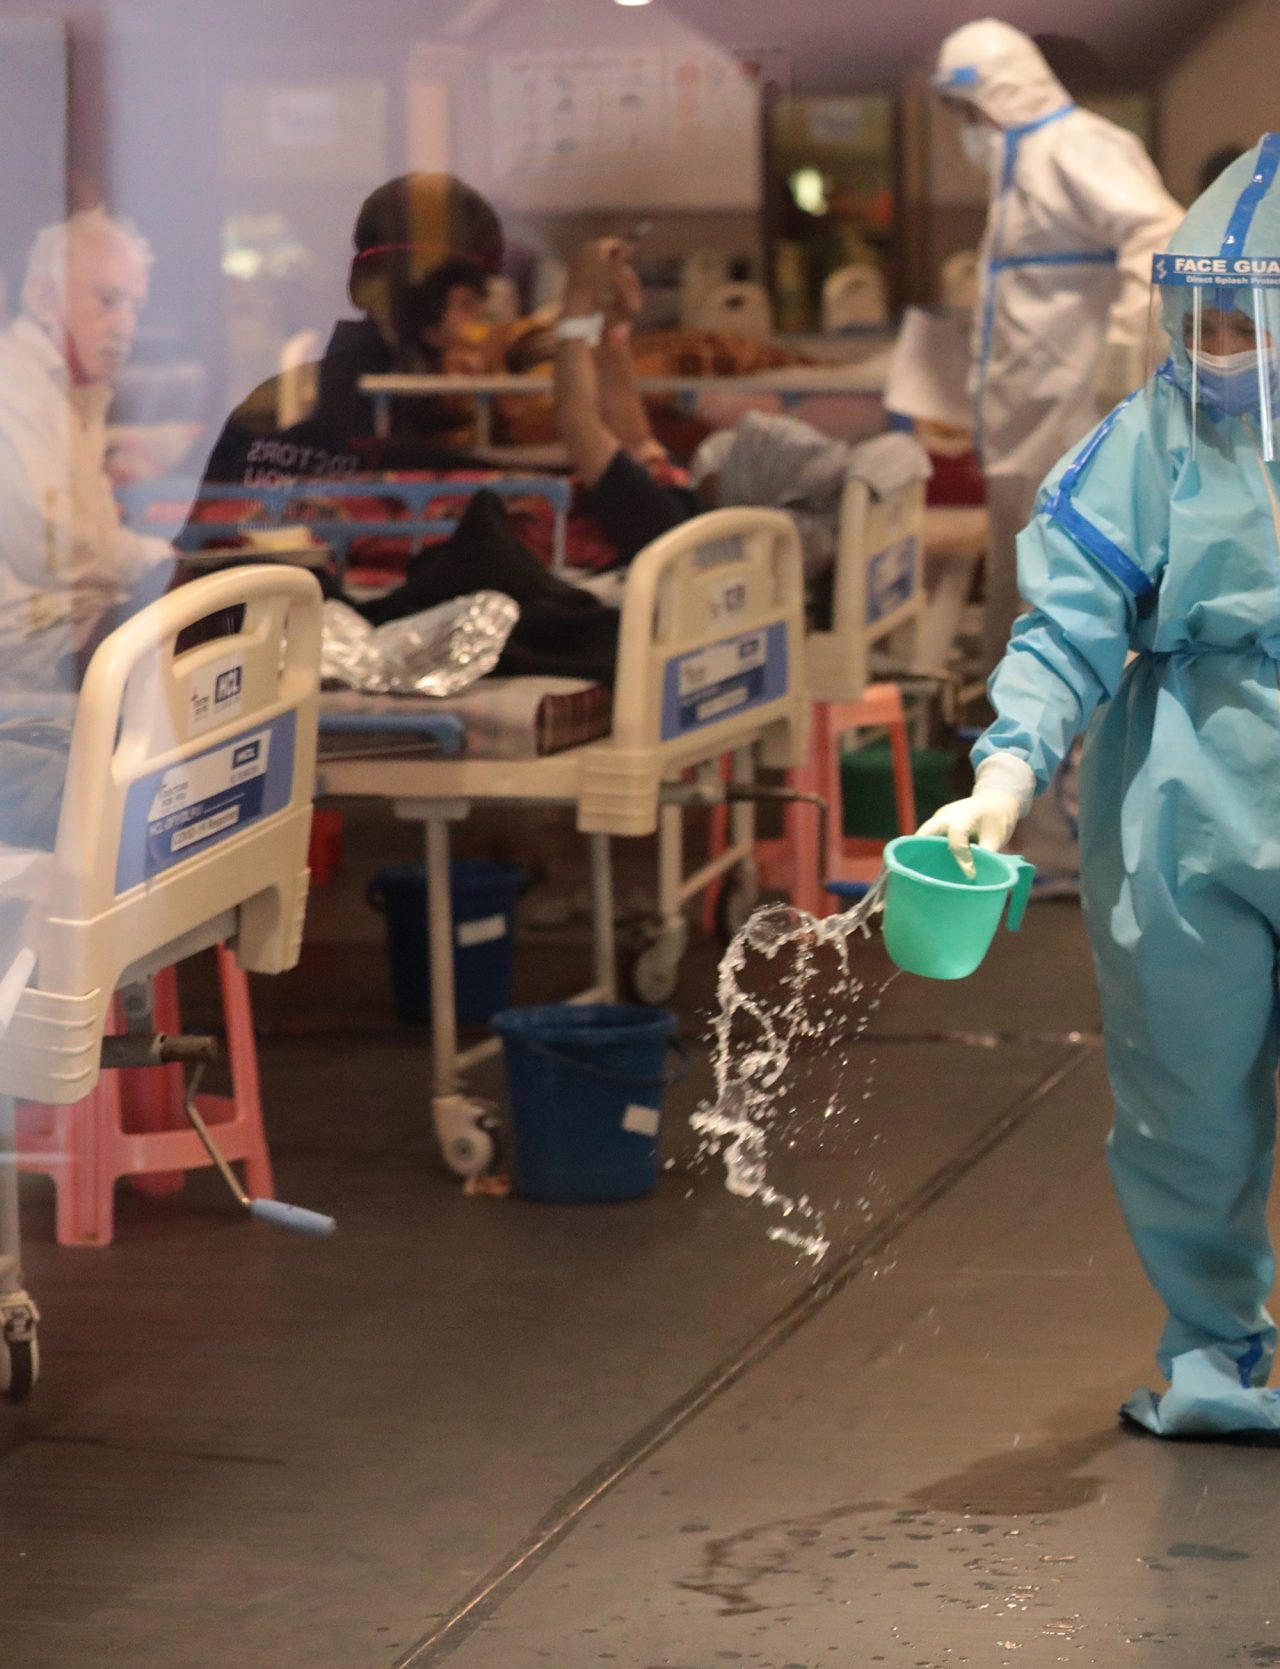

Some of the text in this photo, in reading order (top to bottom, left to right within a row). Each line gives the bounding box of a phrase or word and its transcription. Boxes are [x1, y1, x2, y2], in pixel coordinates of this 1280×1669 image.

[1174, 257, 1227, 273] FACE
[1186, 275, 1213, 284] Direct
[1215, 276, 1248, 286] Splash
[216, 669, 241, 701] HCL
